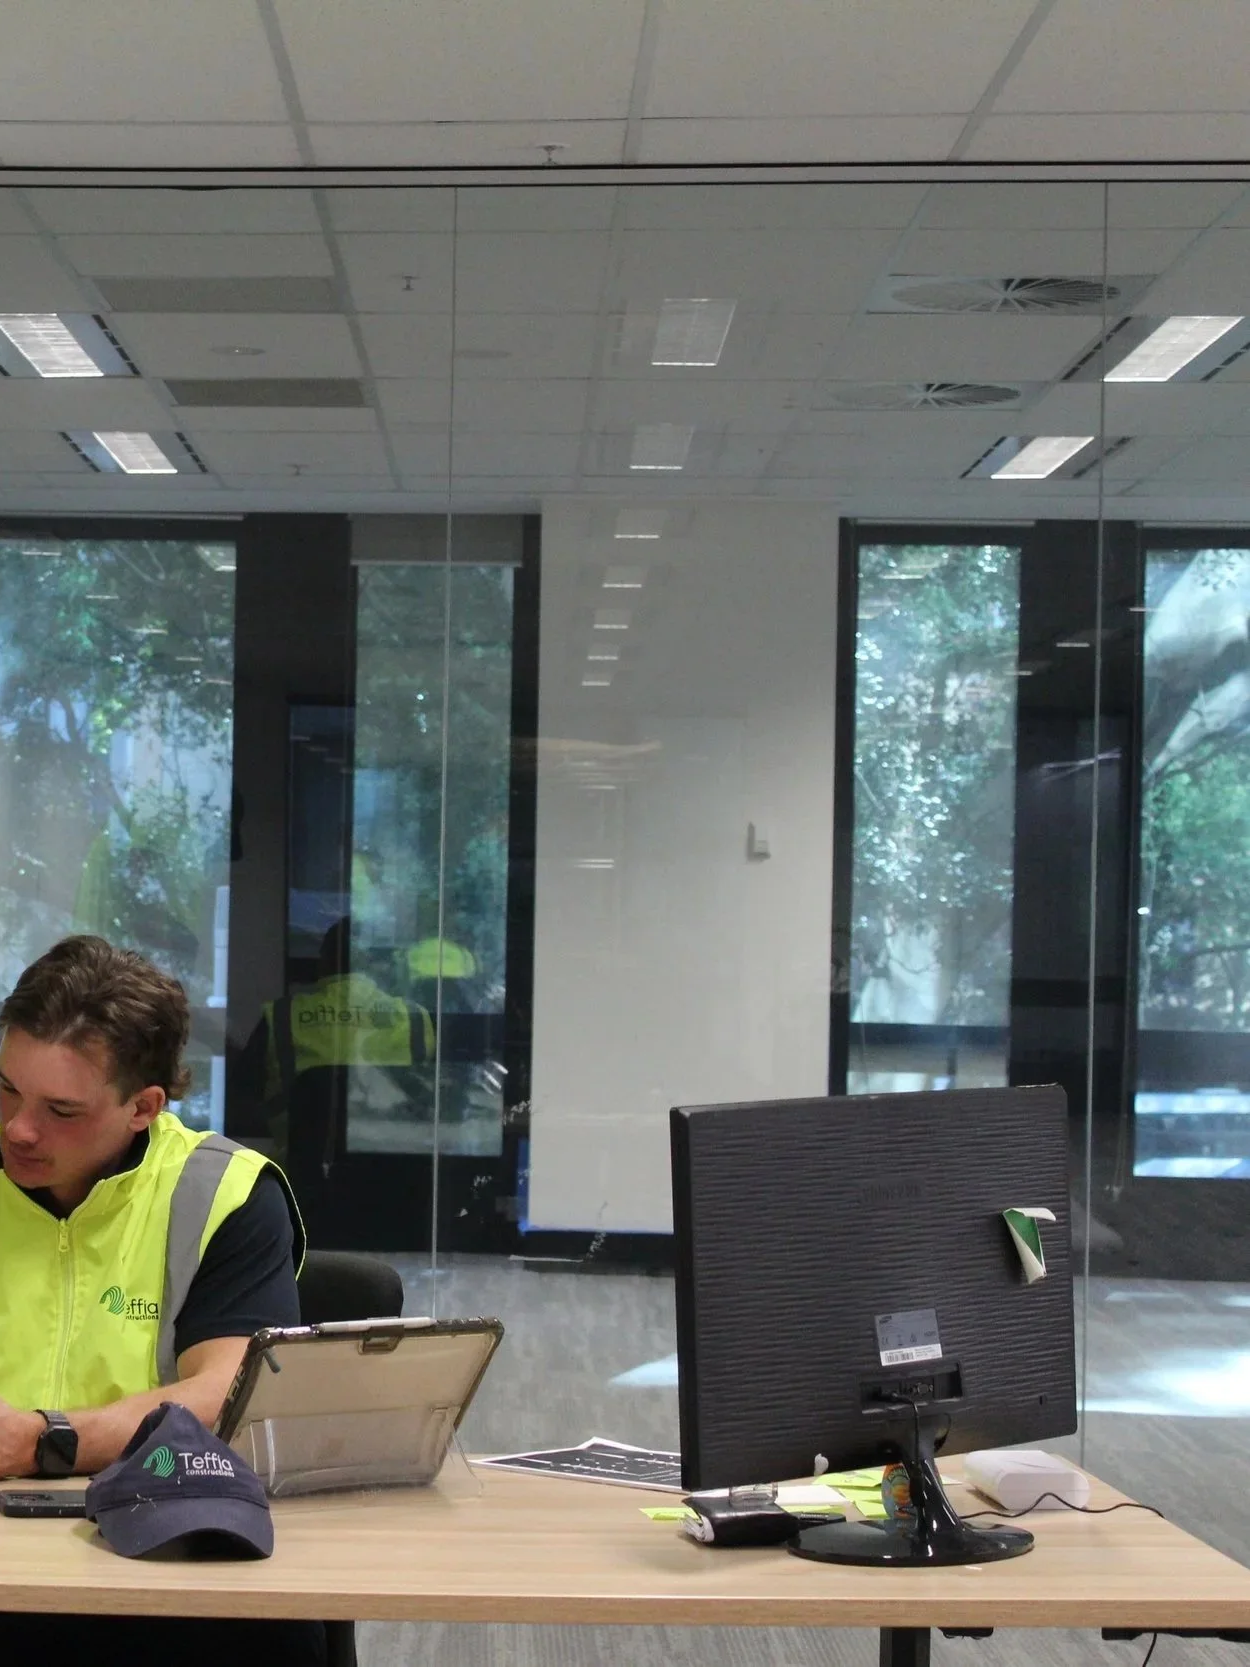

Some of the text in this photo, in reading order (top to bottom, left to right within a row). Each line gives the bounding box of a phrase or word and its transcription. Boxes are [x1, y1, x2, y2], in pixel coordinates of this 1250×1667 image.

[126, 1298, 159, 1315] effia
[178, 1451, 233, 1472] Teffia
[185, 1468, 235, 1478] constructions
